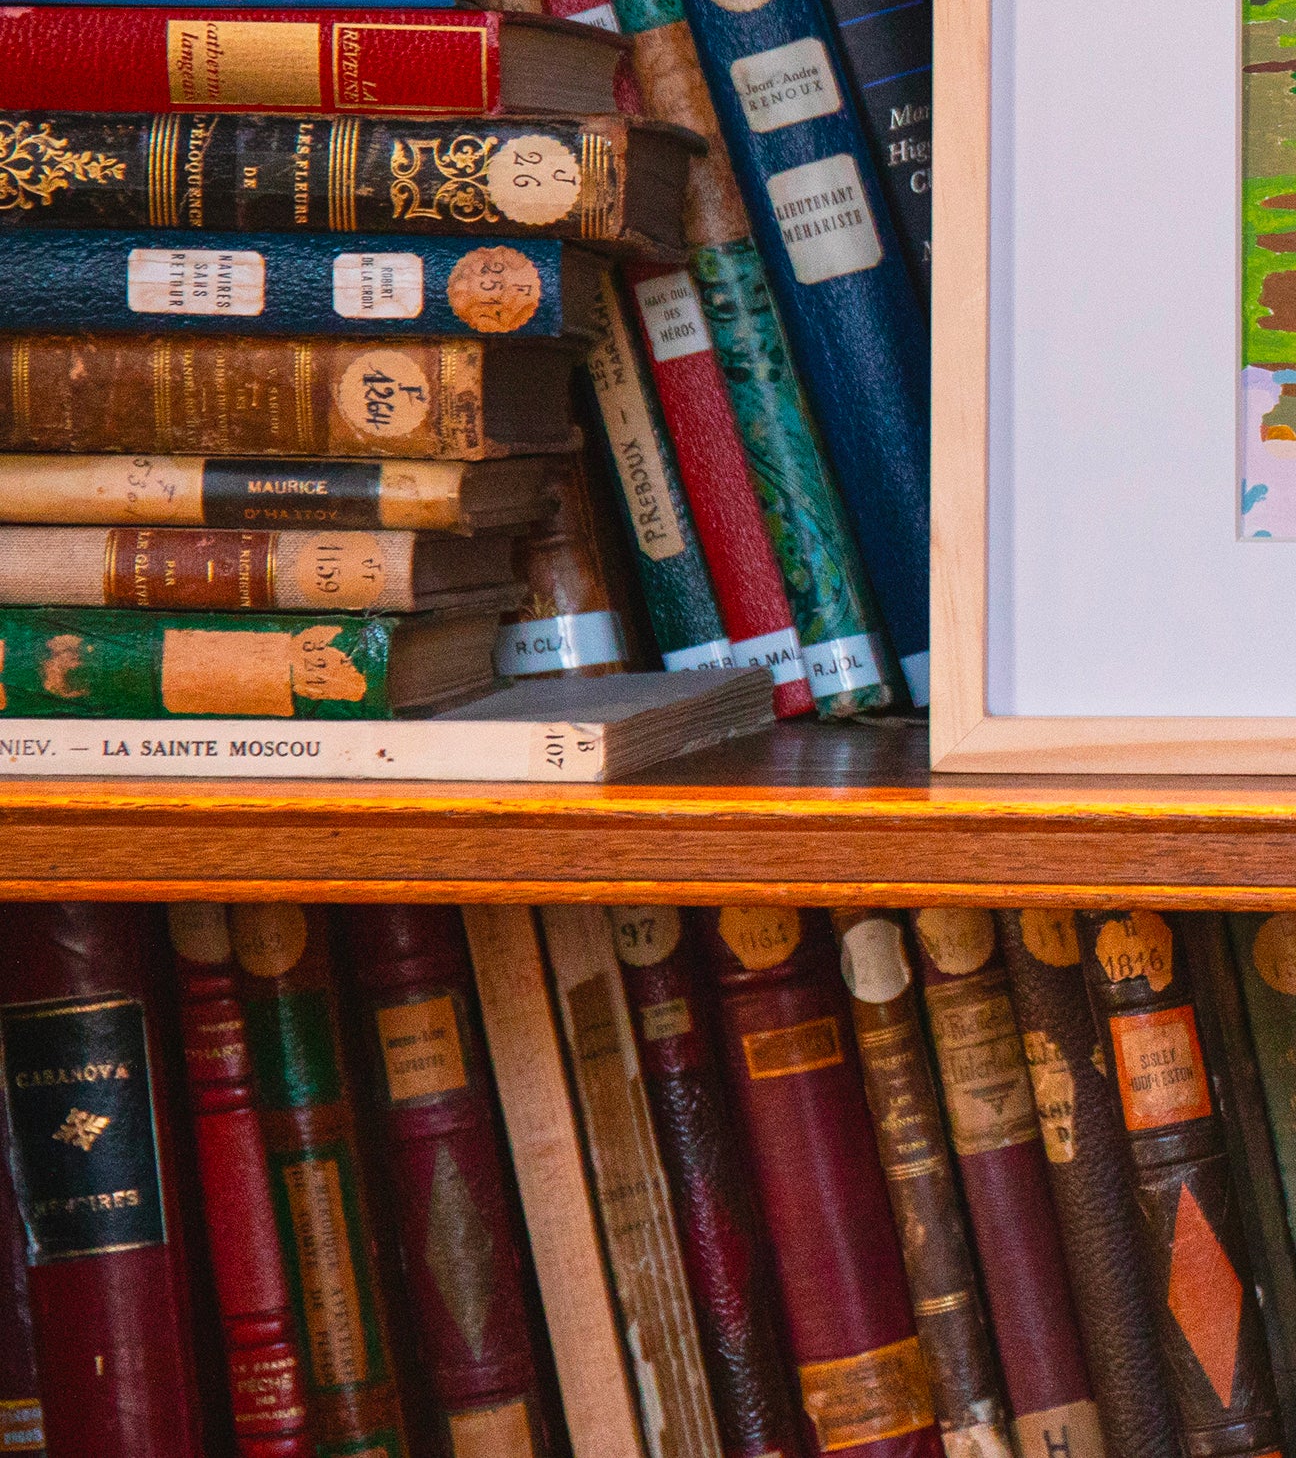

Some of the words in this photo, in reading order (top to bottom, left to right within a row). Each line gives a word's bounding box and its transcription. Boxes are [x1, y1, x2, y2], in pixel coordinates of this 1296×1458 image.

[362, 81, 378, 103] LA
[748, 80, 824, 112] RENOUX
[296, 123, 314, 155] LES
[243, 167, 259, 189] DE
[513, 150, 542, 189] 26
[774, 186, 854, 222] LIEUTENANT
[782, 208, 863, 245] MÉHARISTE
[360, 256, 373, 269] DE
[169, 253, 185, 307] RETOUR
[194, 263, 208, 298] SANS
[216, 255, 233, 309] NAVIRES
[361, 271, 373, 284] LA
[383, 267, 394, 300] ROBERT
[360, 286, 374, 310] CROIX
[663, 307, 682, 321] DES
[660, 320, 697, 344] HÉROS
[247, 480, 329, 495] MAURICE
[812, 653, 864, 677] R.JOL
[102, 739, 131, 757] LA
[140, 739, 218, 757] SAINTE
[229, 739, 321, 758] MOSCOU
[545, 728, 565, 770] 107
[1140, 1047, 1176, 1070] SISLEY
